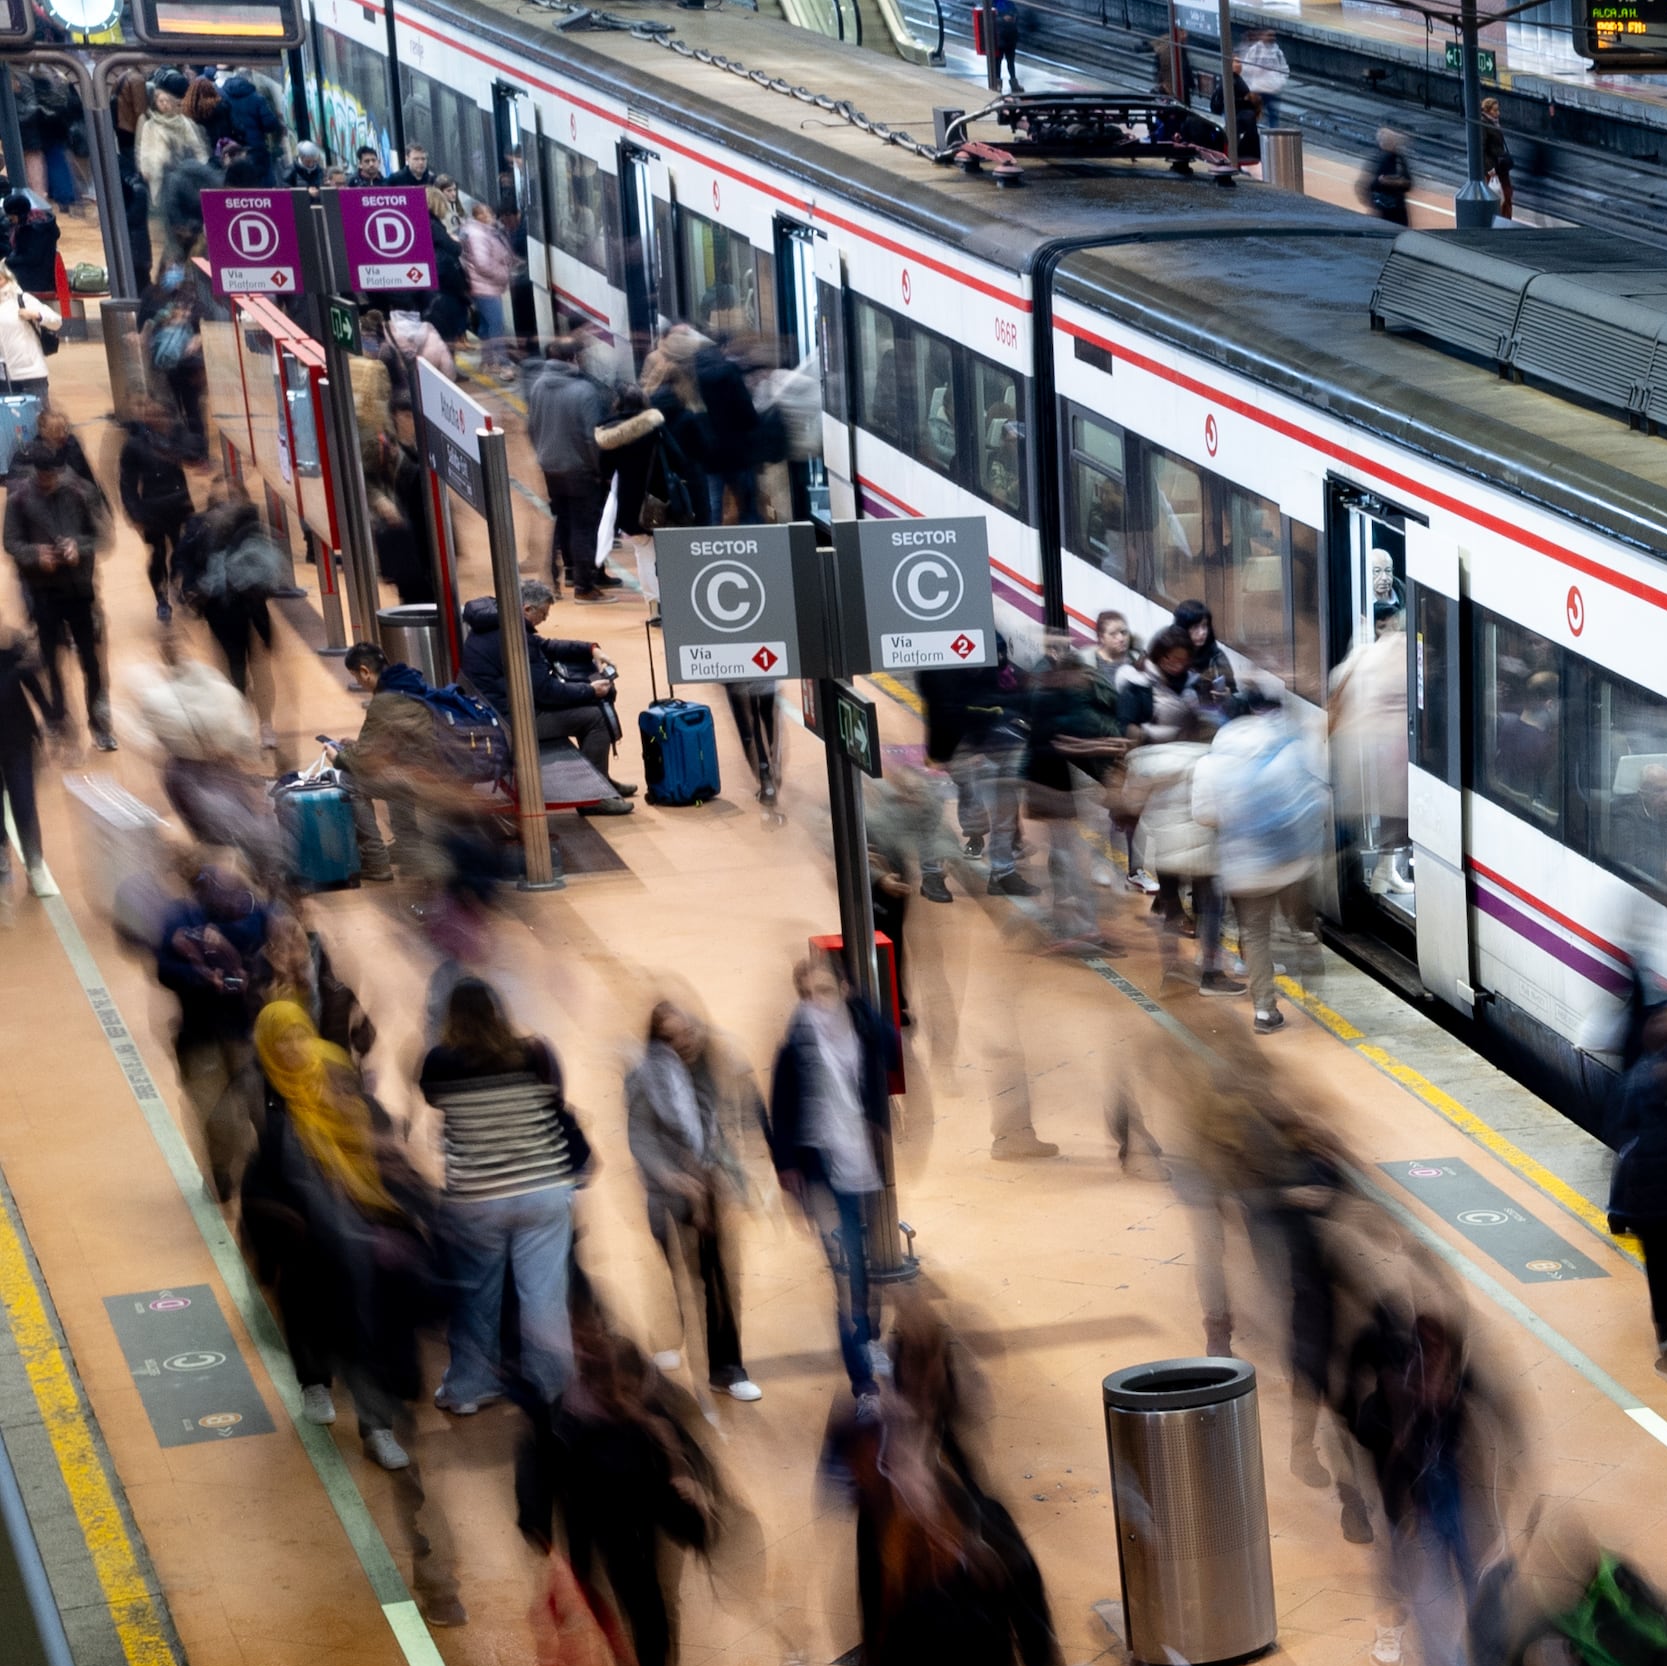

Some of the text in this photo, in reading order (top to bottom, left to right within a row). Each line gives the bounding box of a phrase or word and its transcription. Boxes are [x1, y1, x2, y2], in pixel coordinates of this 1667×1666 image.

[225, 197, 272, 209] SECTOR
[362, 195, 407, 206] SECTOR
[239, 218, 270, 253] D
[376, 215, 406, 250] D
[228, 279, 266, 292] Platform
[365, 276, 404, 288] Platform
[995, 316, 1018, 351] 066R
[891, 530, 957, 547] SECTOR
[690, 540, 759, 556] SECTOR
[906, 561, 950, 611] C
[706, 571, 751, 622] C
[891, 649, 945, 666] Platform
[690, 661, 745, 678] Platform
